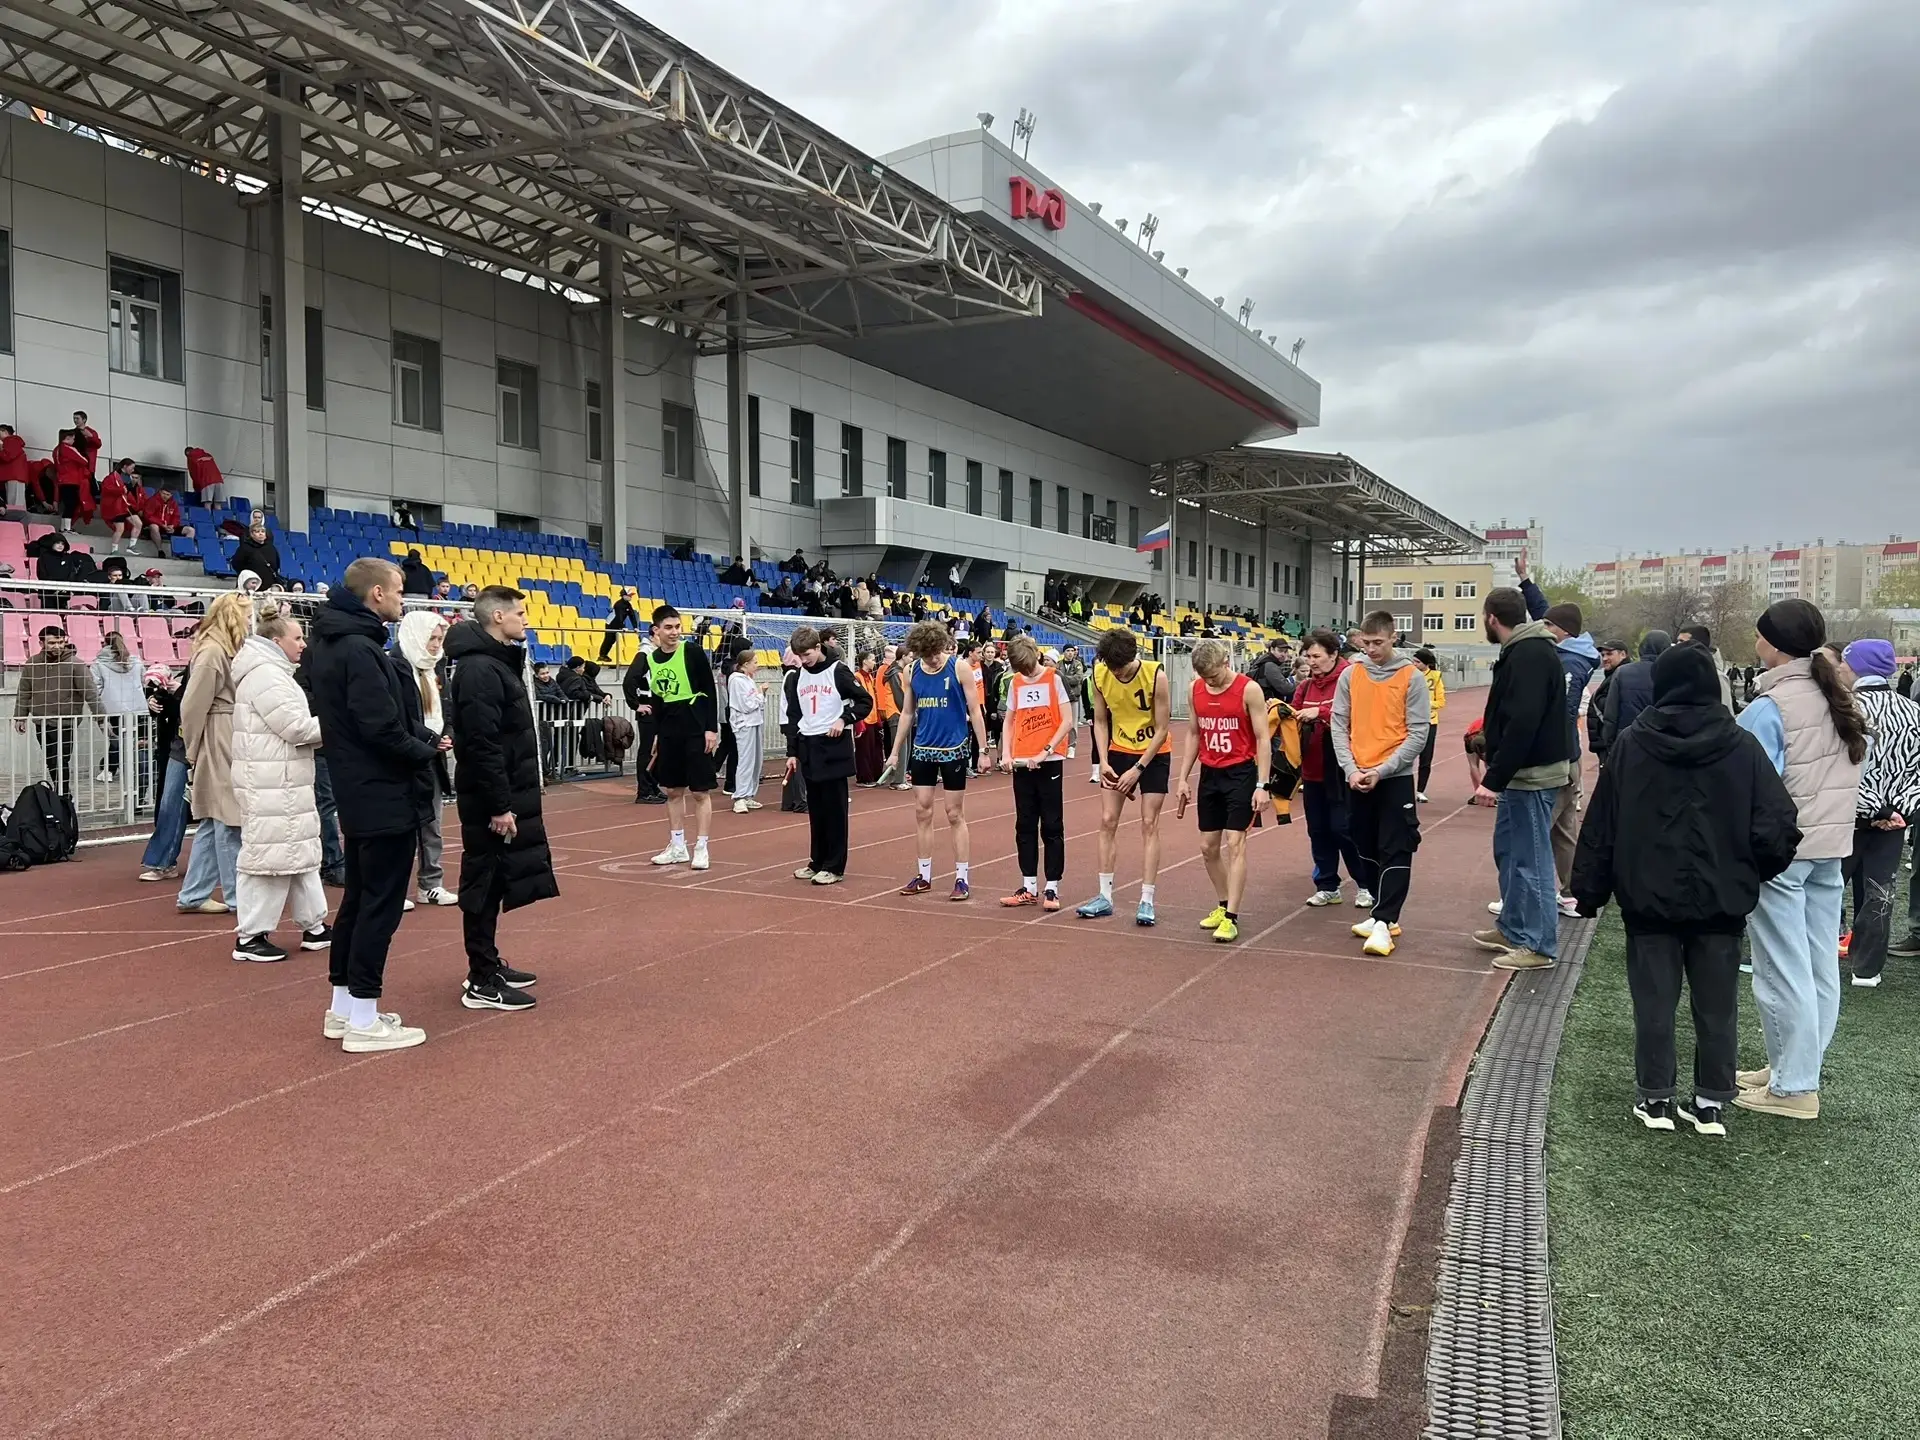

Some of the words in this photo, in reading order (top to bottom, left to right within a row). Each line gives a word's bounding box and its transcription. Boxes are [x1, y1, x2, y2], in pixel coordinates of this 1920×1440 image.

[943, 676, 951, 690] 1
[1427, 678, 1435, 691] 2
[939, 697, 948, 708] 15
[1026, 690, 1040, 703] 53
[1134, 688, 1151, 711] 1
[810, 694, 818, 715] 1
[1217, 717, 1239, 731] СОШ
[1136, 725, 1156, 743] 80
[1203, 732, 1232, 753] 145
